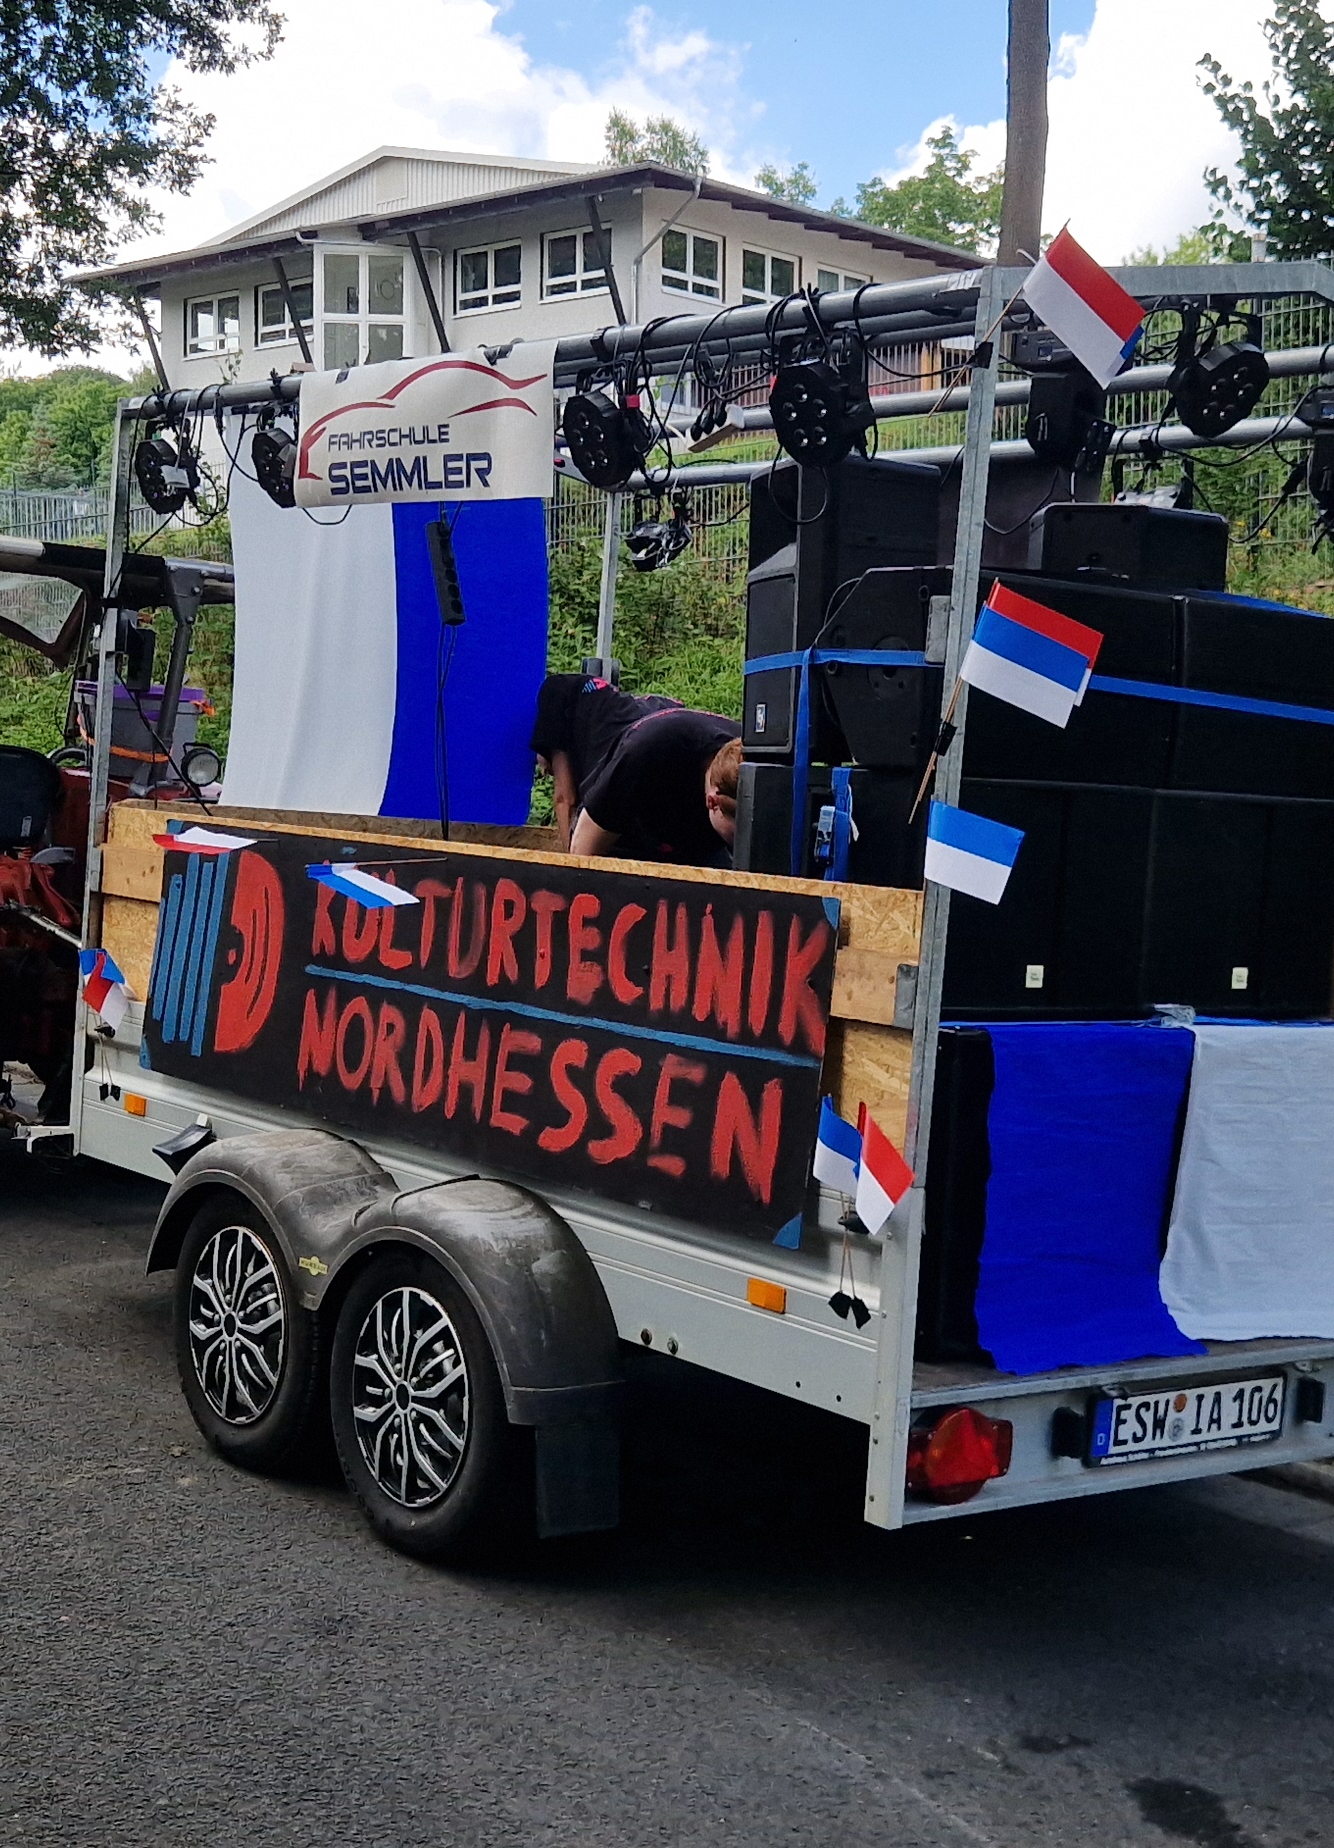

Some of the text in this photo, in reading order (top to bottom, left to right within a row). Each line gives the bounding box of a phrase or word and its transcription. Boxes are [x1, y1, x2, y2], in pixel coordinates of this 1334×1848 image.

[328, 424, 450, 452] FAHRSCHULE
[328, 451, 493, 496] SEMMLER
[312, 860, 828, 1057] KULTURTECHNIK
[297, 986, 783, 1204] NORDHESSEN
[1096, 1383, 1279, 1447] D ESW IA 106
